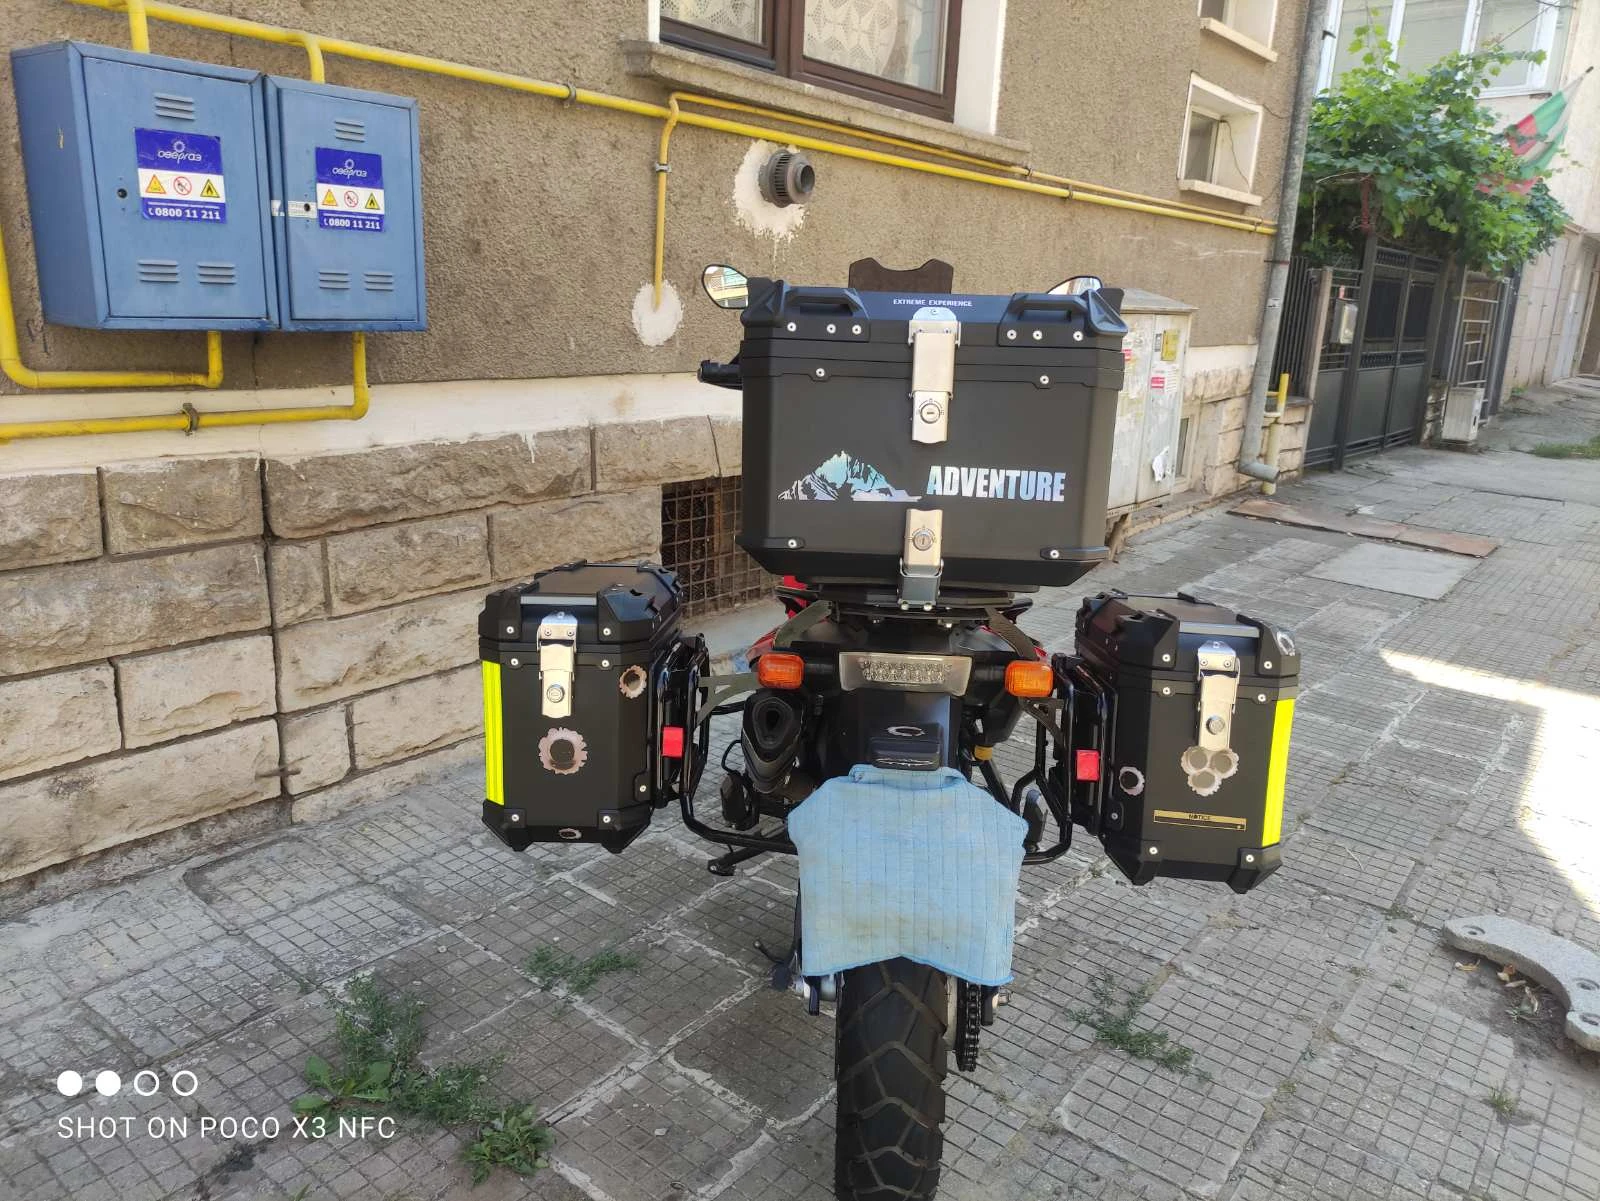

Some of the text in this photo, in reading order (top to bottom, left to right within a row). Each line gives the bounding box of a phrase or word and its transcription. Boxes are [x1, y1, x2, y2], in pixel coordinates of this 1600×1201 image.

[155, 207, 221, 220] 0800 11 211
[328, 218, 381, 230] 0800 11 211
[928, 299, 973, 307] EXPERIENCE
[926, 465, 1067, 502] ADVENTURE
